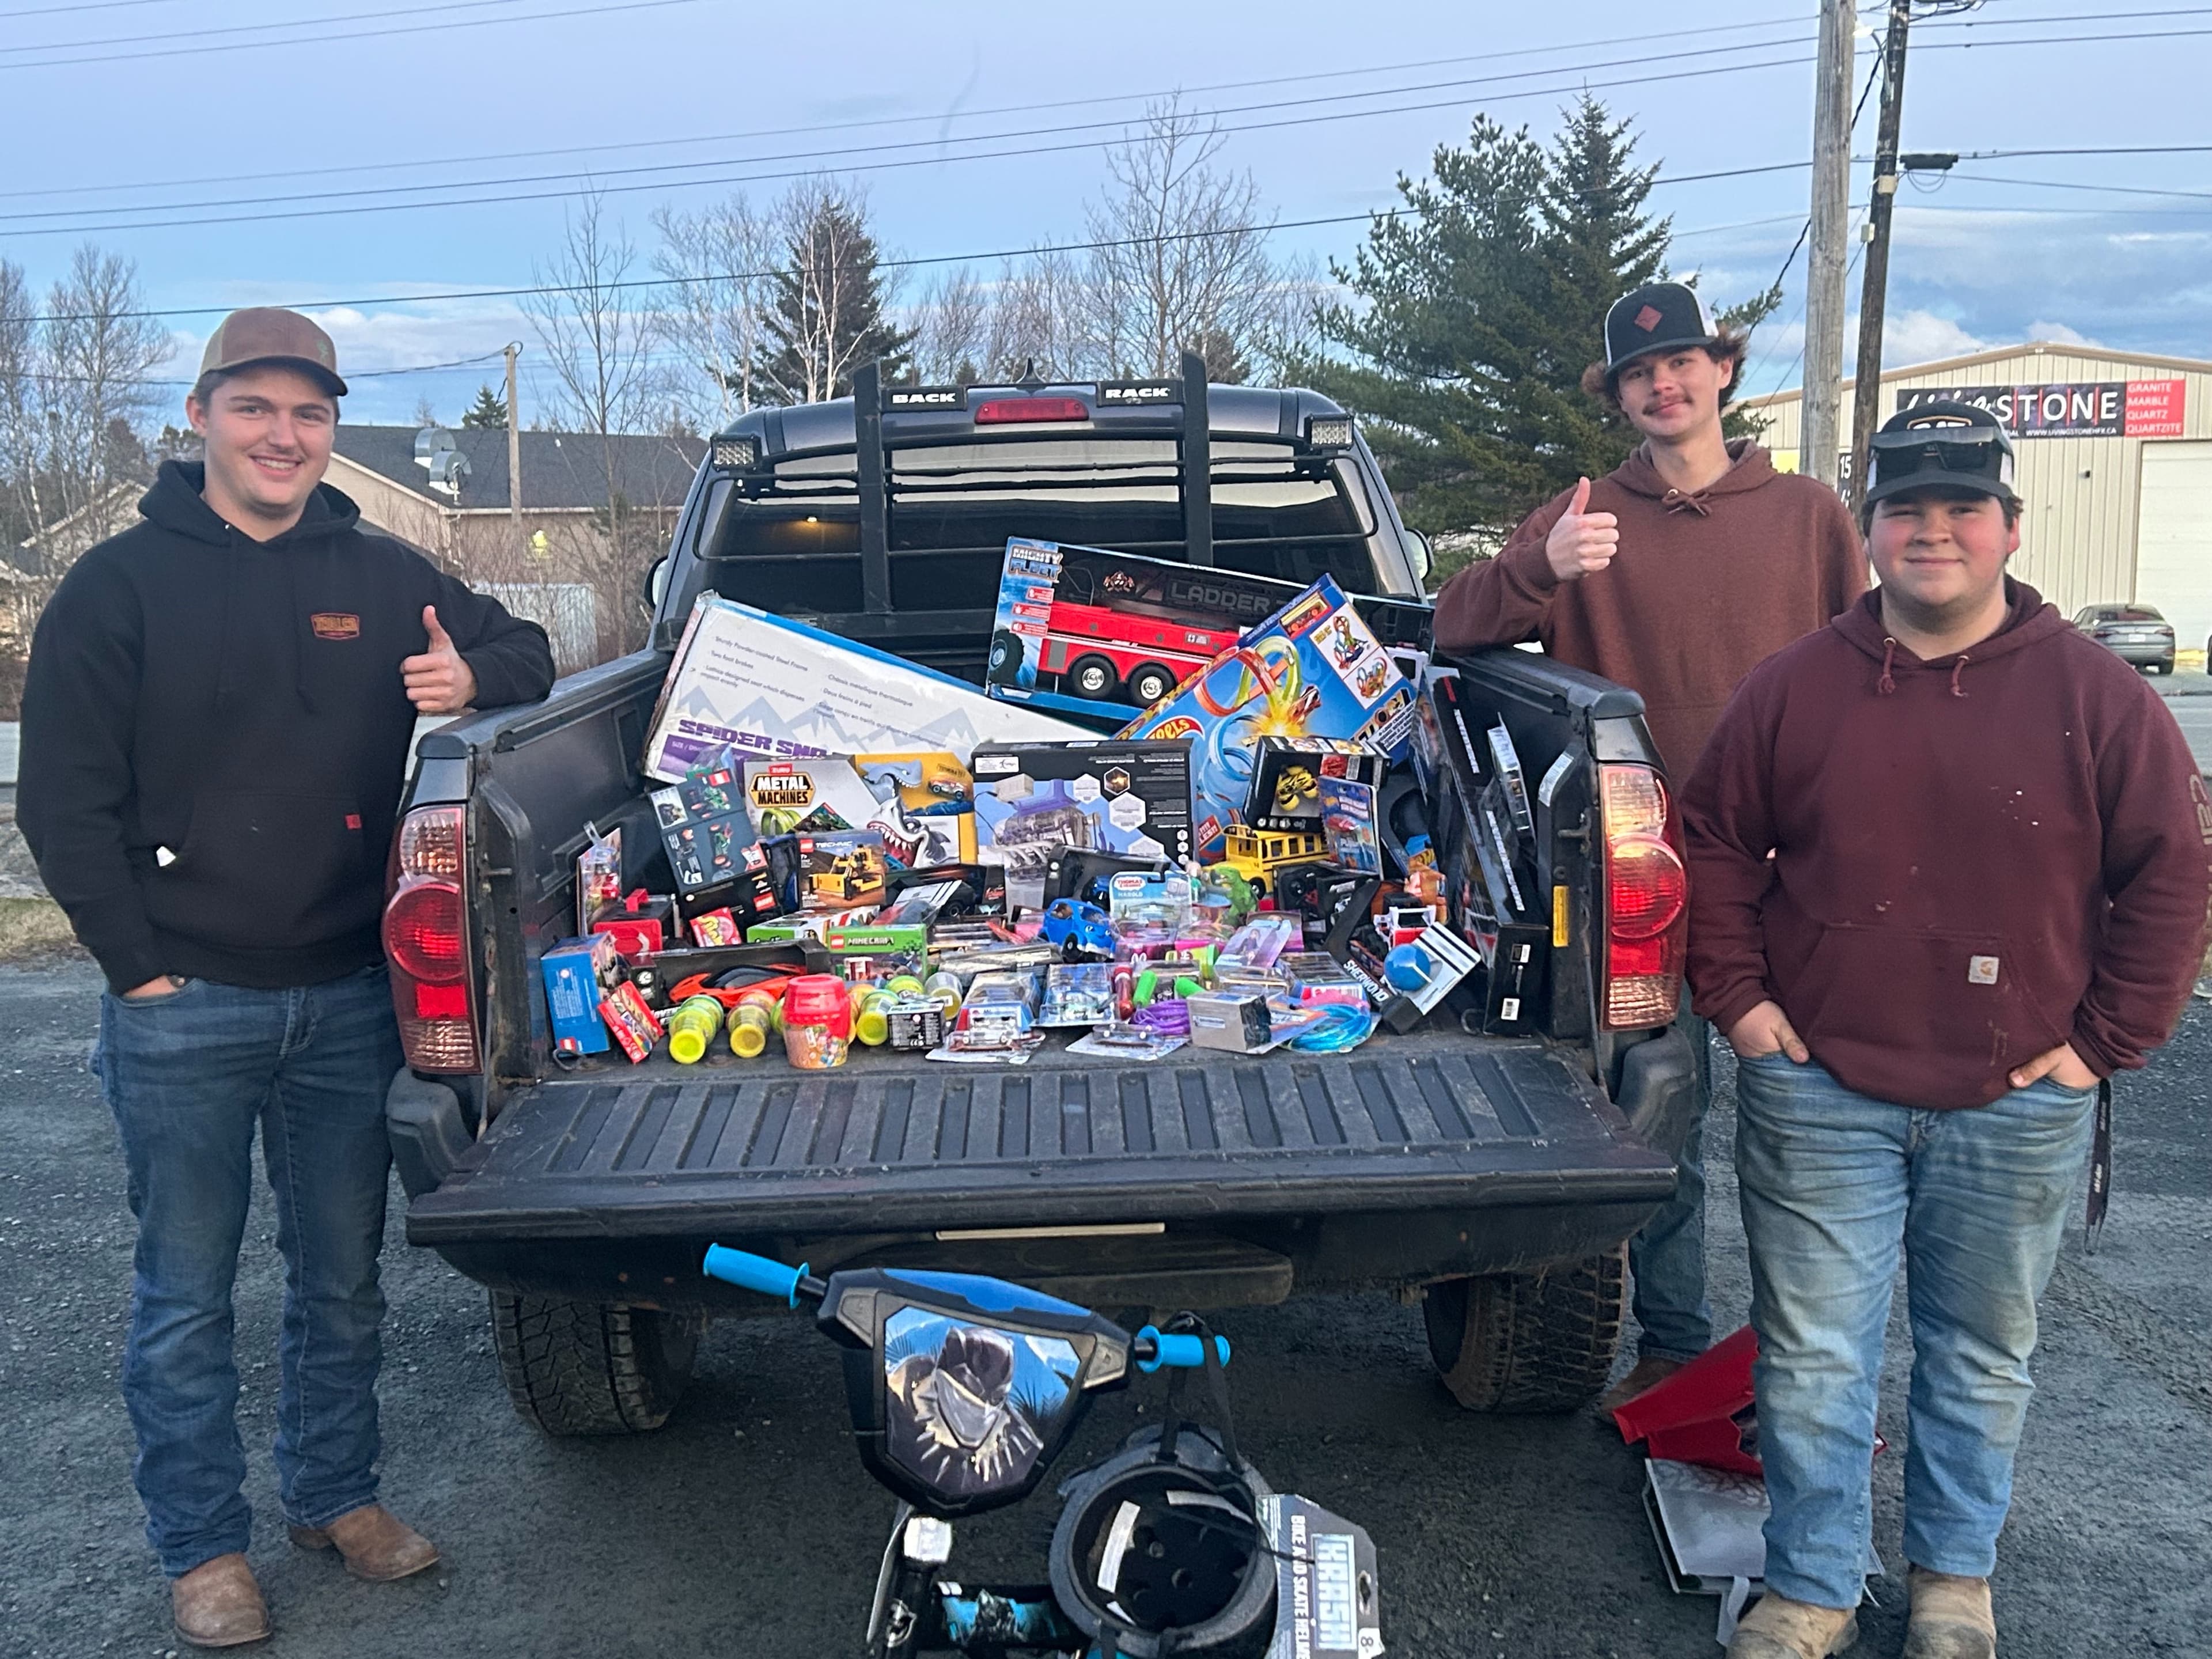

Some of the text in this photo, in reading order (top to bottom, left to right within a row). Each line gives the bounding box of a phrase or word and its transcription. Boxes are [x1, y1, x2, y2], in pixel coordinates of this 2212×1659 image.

[892, 387, 1171, 403] BACK RACK
[2128, 383, 2172, 393] GRANITE
[1996, 391, 2118, 422] STONE
[2127, 396, 2169, 407] MARBLE
[2127, 410, 2168, 420] QUARTZ
[2126, 422, 2183, 434] QUARTZITE
[1010, 558, 1063, 579] FLEET
[1171, 582, 1271, 613] LADDER
[678, 719, 772, 751] SPIDER
[757, 775, 808, 791] METAL
[757, 790, 808, 805] MACHINES
[847, 937, 894, 946] MINECRAFT
[1290, 1515, 1306, 1544] BIKE
[1293, 1576, 1309, 1617] SKATE
[1317, 1542, 1351, 1643] KRASH
[1295, 1618, 1311, 1659] HELME
